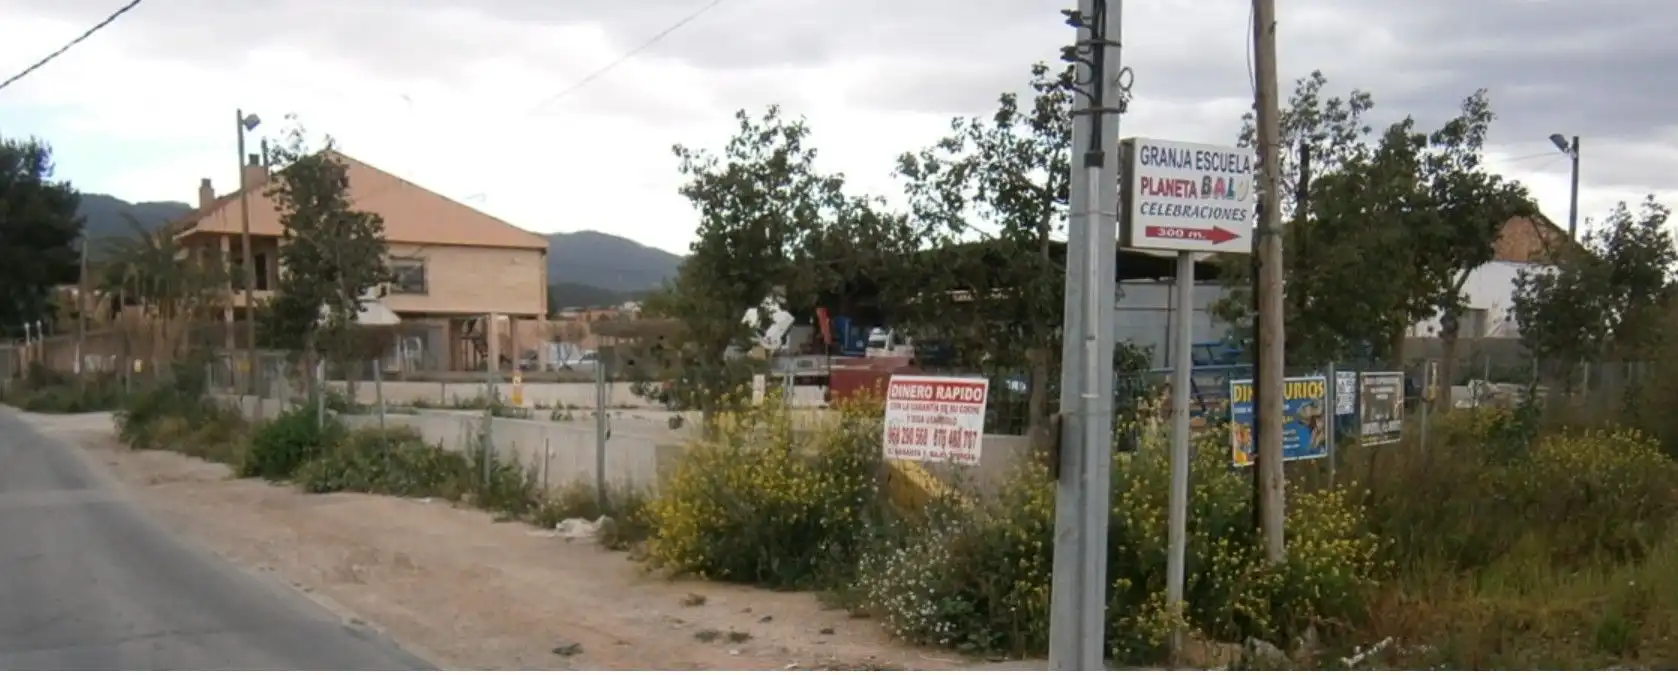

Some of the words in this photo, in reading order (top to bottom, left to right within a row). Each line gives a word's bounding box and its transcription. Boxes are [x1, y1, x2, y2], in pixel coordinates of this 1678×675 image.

[1140, 145, 1193, 170] GRANJA
[1195, 150, 1252, 174] ESCUELA
[1140, 176, 1198, 199] PLANETA
[1140, 202, 1249, 221] CELEBRACIONES
[1156, 227, 1184, 238] 300
[891, 384, 933, 400] DINERO
[936, 386, 983, 402] RAPIDO
[1233, 381, 1325, 403] DINURIOS
